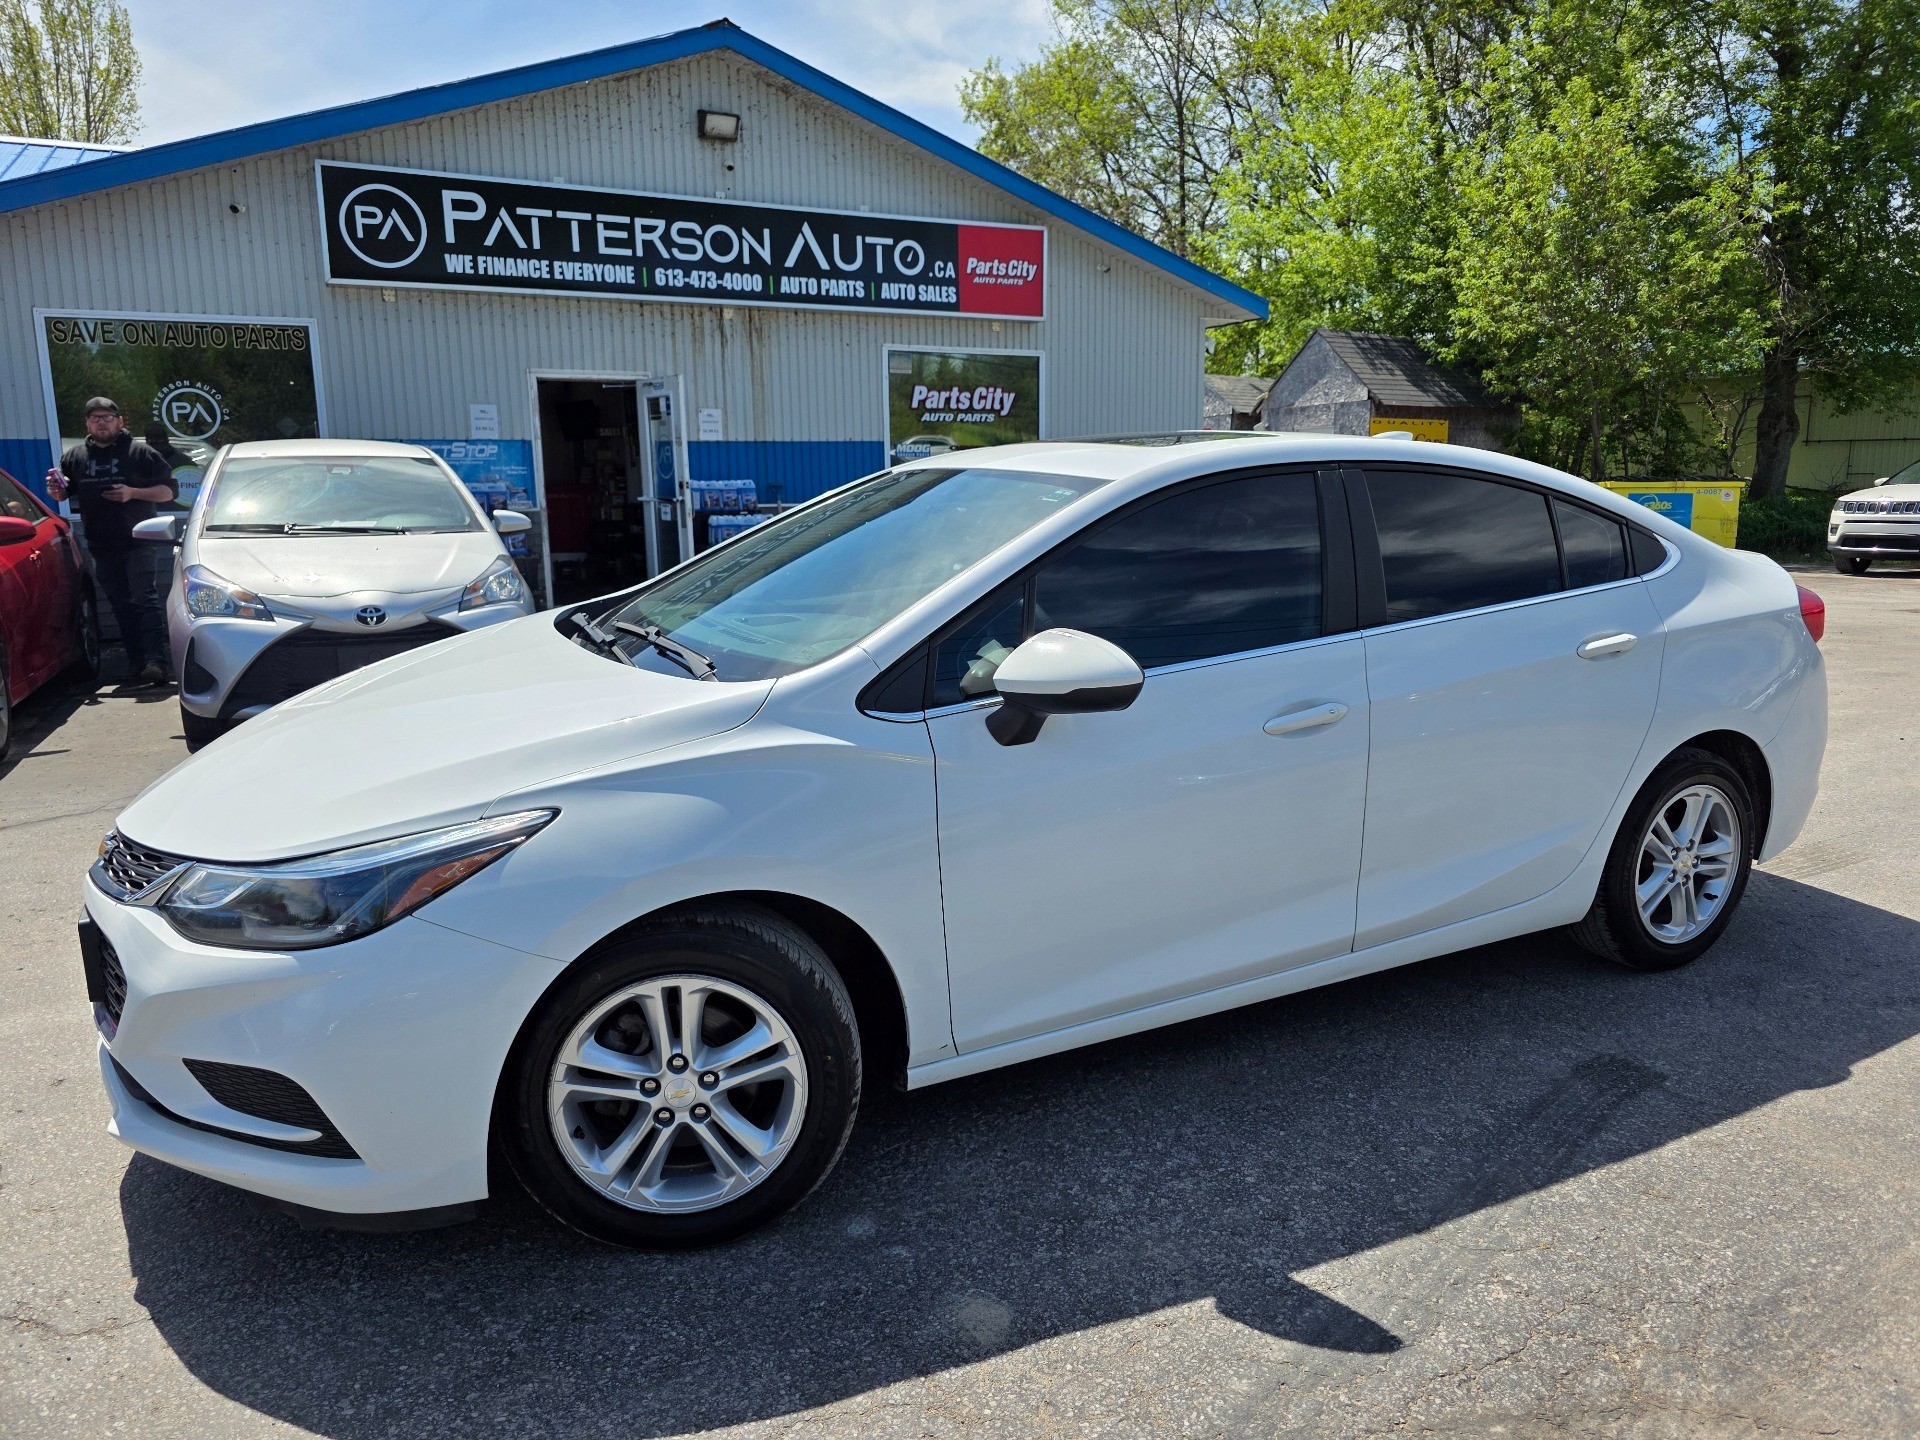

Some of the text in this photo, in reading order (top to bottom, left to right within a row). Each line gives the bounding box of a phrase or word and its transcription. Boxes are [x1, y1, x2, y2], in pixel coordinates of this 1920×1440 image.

[354, 204, 415, 242] PA
[441, 188, 771, 265] PATTERSON
[444, 253, 635, 285] WE FINANCE EVERYONE
[654, 267, 763, 293] 613-473-4000
[973, 276, 1024, 286] AUTO PARTS
[780, 275, 865, 299] AUTO PARTS
[881, 282, 957, 304] AUTO SALES
[51, 319, 306, 351] SAVE ON AUTO PARTS
[152, 380, 190, 422] PATTERSON
[171, 401, 213, 423] PA
[921, 412, 995, 423] AUTO PARTS
[896, 444, 930, 453] MOOG
